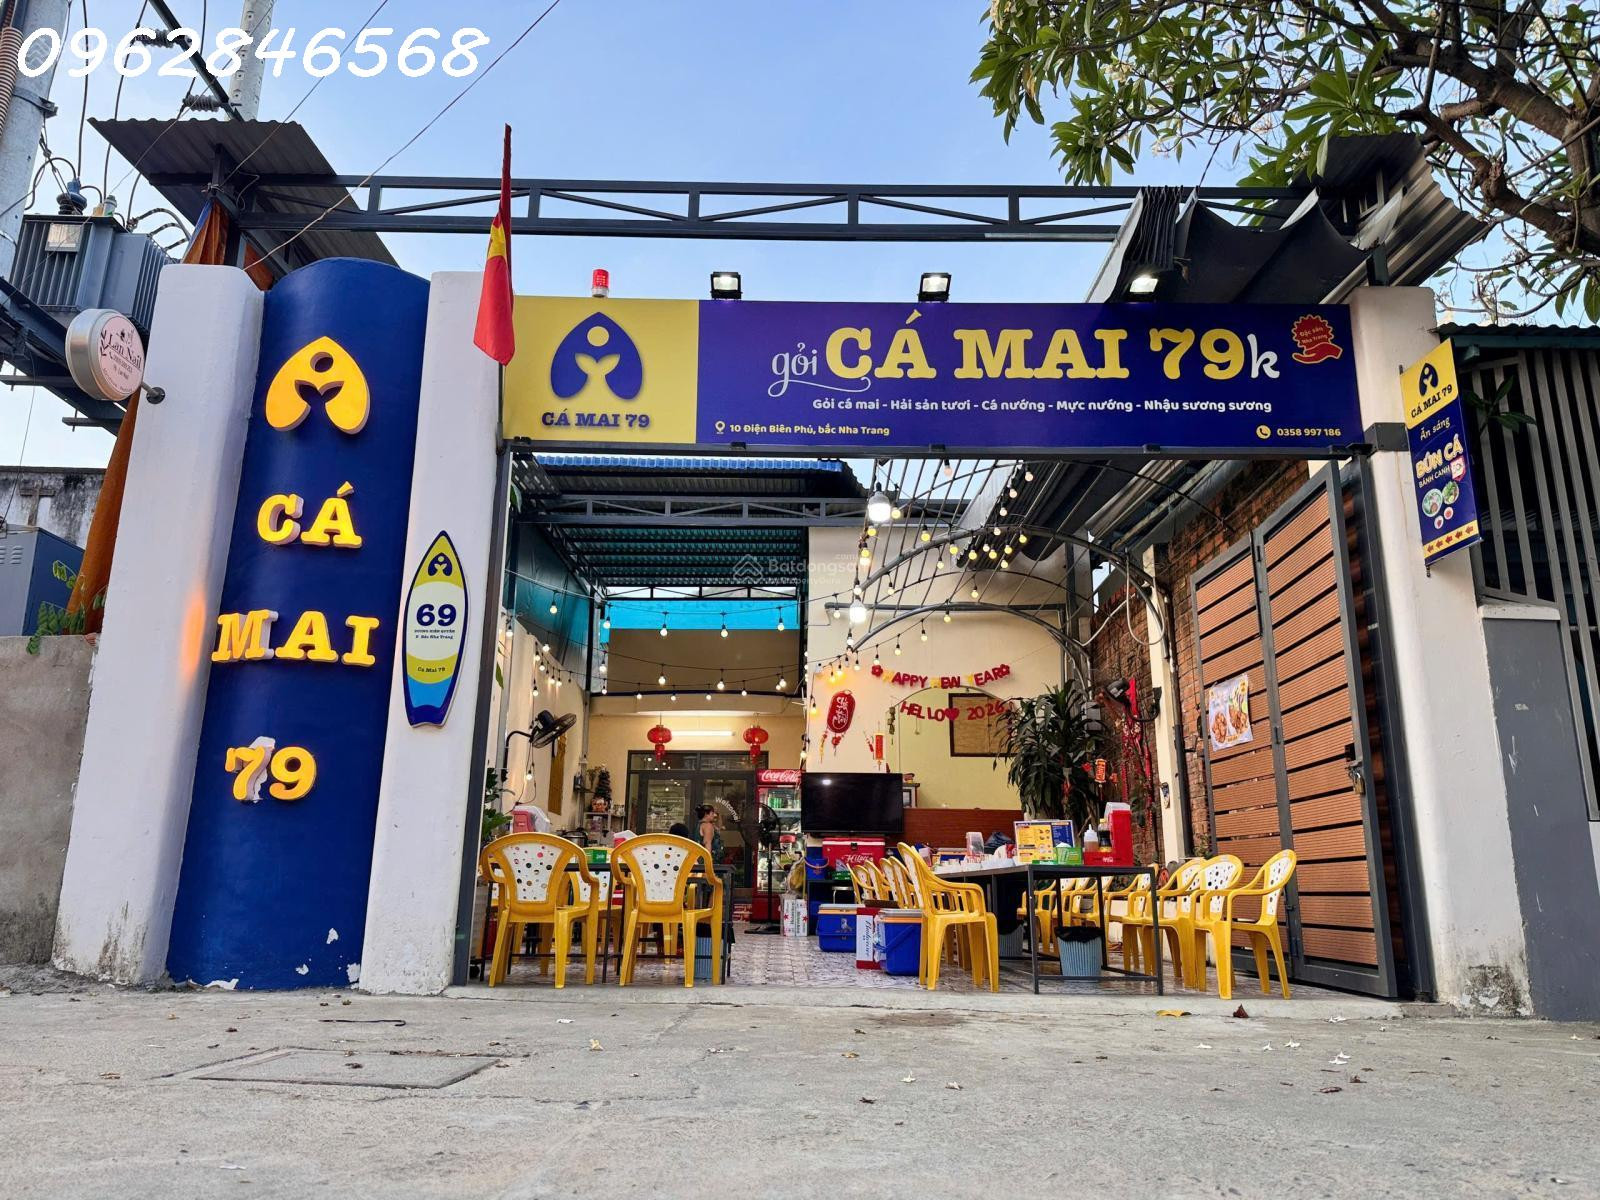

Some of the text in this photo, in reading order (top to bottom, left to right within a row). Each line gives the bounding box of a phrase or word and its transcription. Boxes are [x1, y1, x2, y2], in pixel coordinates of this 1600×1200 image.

[826, 308, 937, 379] CÁ
[953, 328, 1130, 379] MAI
[812, 399, 835, 410] Gỏi
[837, 398, 853, 410] cá
[855, 399, 880, 410] mai
[890, 398, 912, 410] Hải
[915, 398, 938, 411] sản
[941, 399, 971, 411] tươi
[981, 399, 998, 411] Cá
[1001, 399, 1046, 413] nướng
[1056, 400, 1085, 413] Mực
[1088, 398, 1134, 413] nướng
[1144, 398, 1180, 413] Nhậu
[1182, 401, 1226, 413] sương
[1228, 401, 1272, 413] sương
[1411, 384, 1452, 418] CÁ MAI 79
[541, 408, 650, 428] CÁ MAI 79
[729, 424, 741, 433] 10
[743, 423, 767, 435] Điện
[769, 424, 792, 433] Biên
[818, 423, 836, 434] bắc
[838, 426, 858, 434] Nha
[861, 426, 890, 436] Trang
[1277, 428, 1341, 436] 0358 997 186
[257, 481, 363, 549] CÁ
[416, 603, 457, 627] 69
[211, 609, 380, 667] MAI
[224, 740, 316, 803] 79
